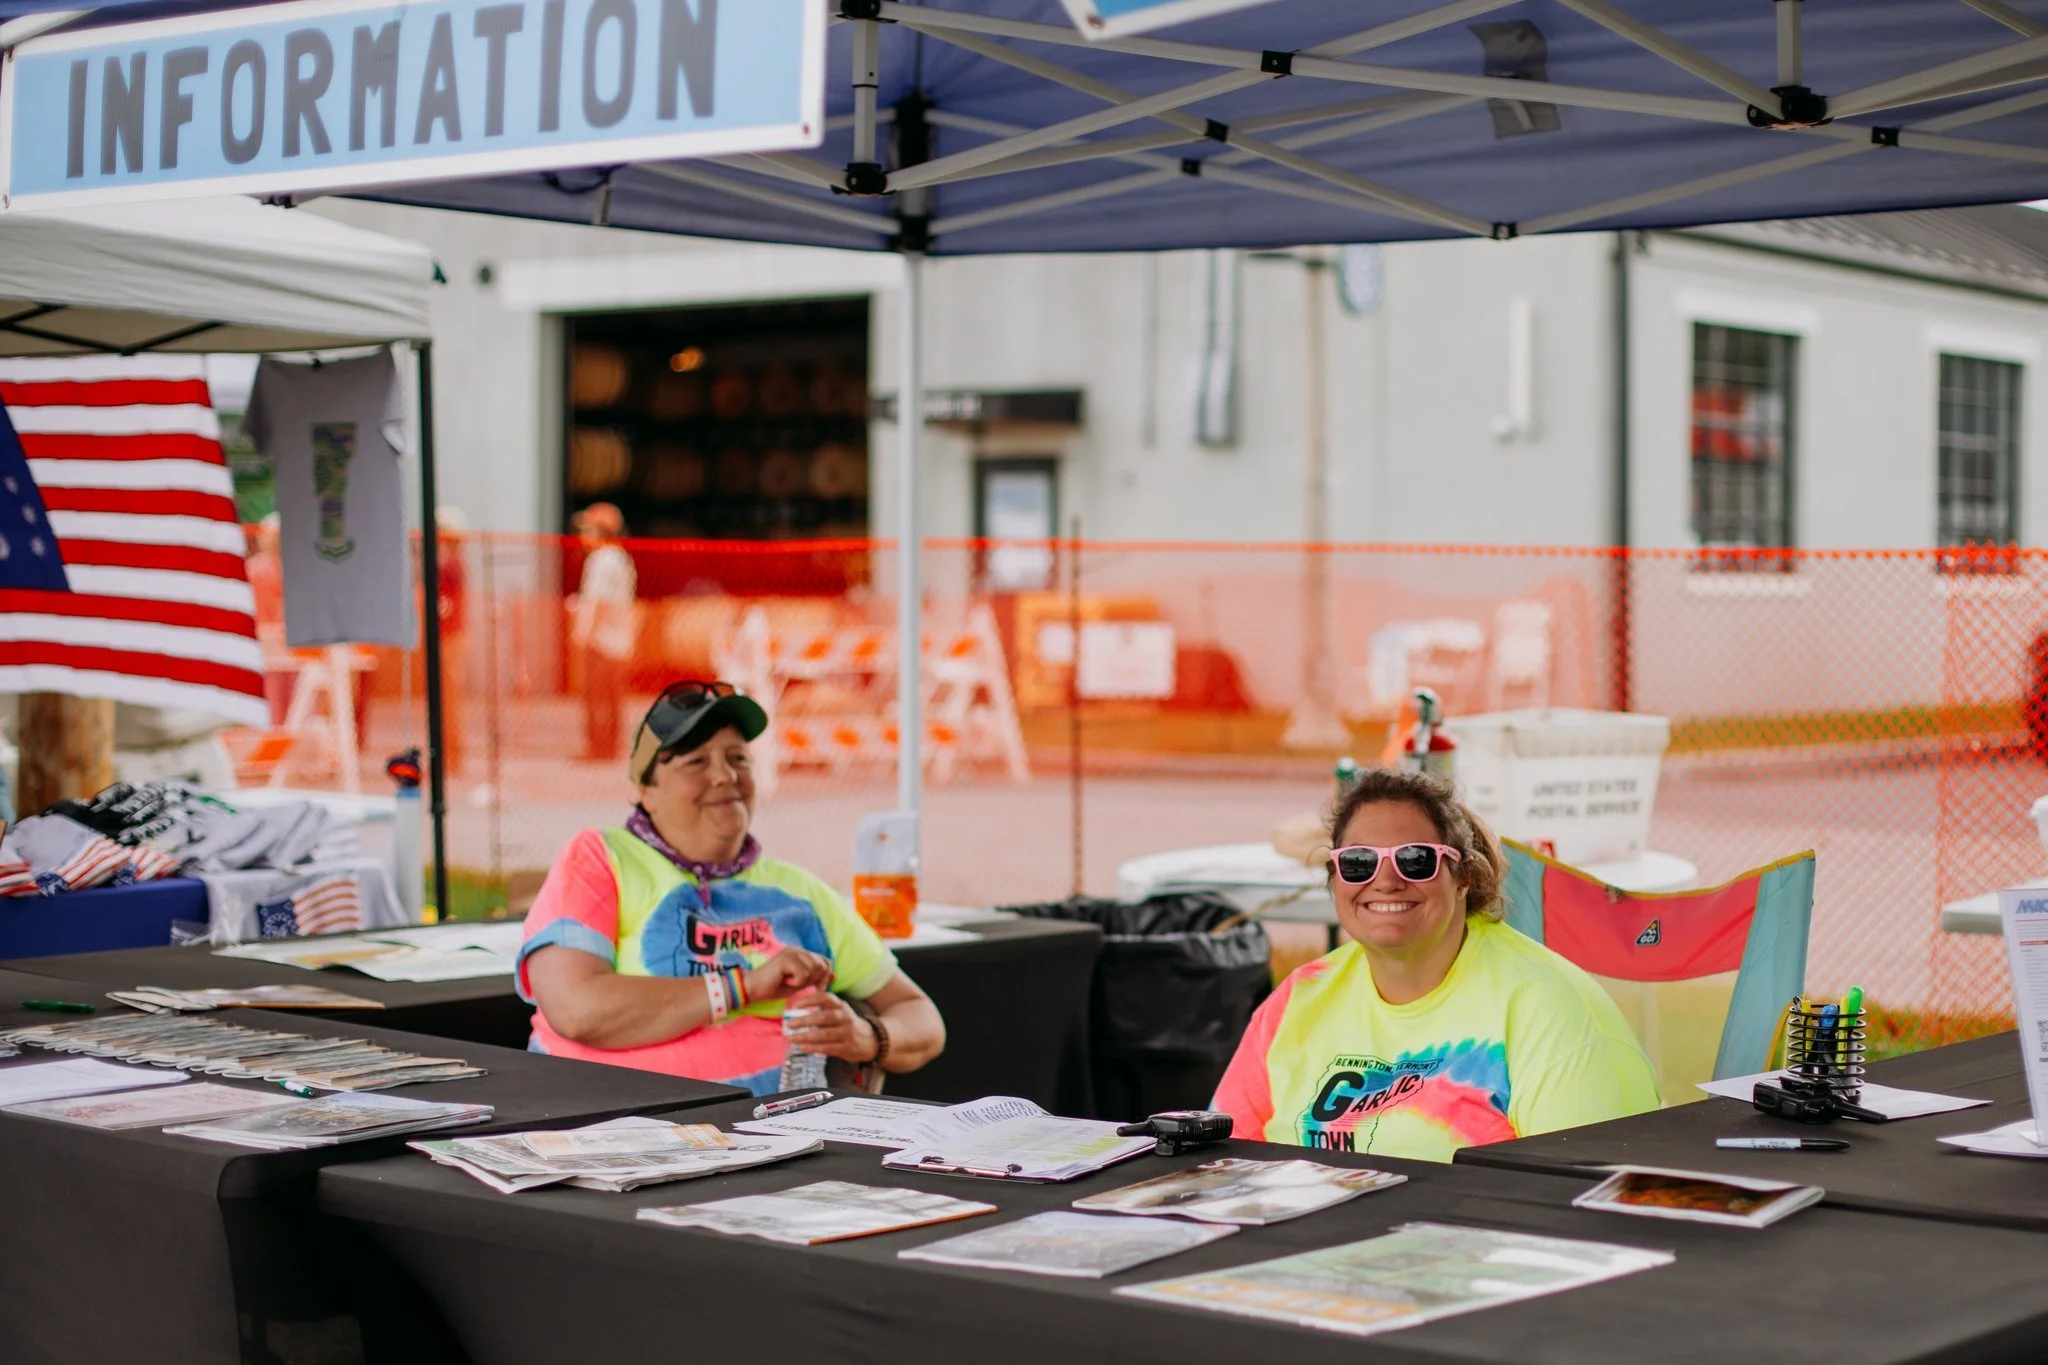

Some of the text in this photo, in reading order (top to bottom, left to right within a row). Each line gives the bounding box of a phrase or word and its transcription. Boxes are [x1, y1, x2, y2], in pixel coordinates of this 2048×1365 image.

[66, 0, 717, 179] INFORMATION
[1586, 777, 1638, 794] STATES
[1312, 1071, 1421, 1122] GARLIC
[1308, 1130, 1355, 1153] TOWN
